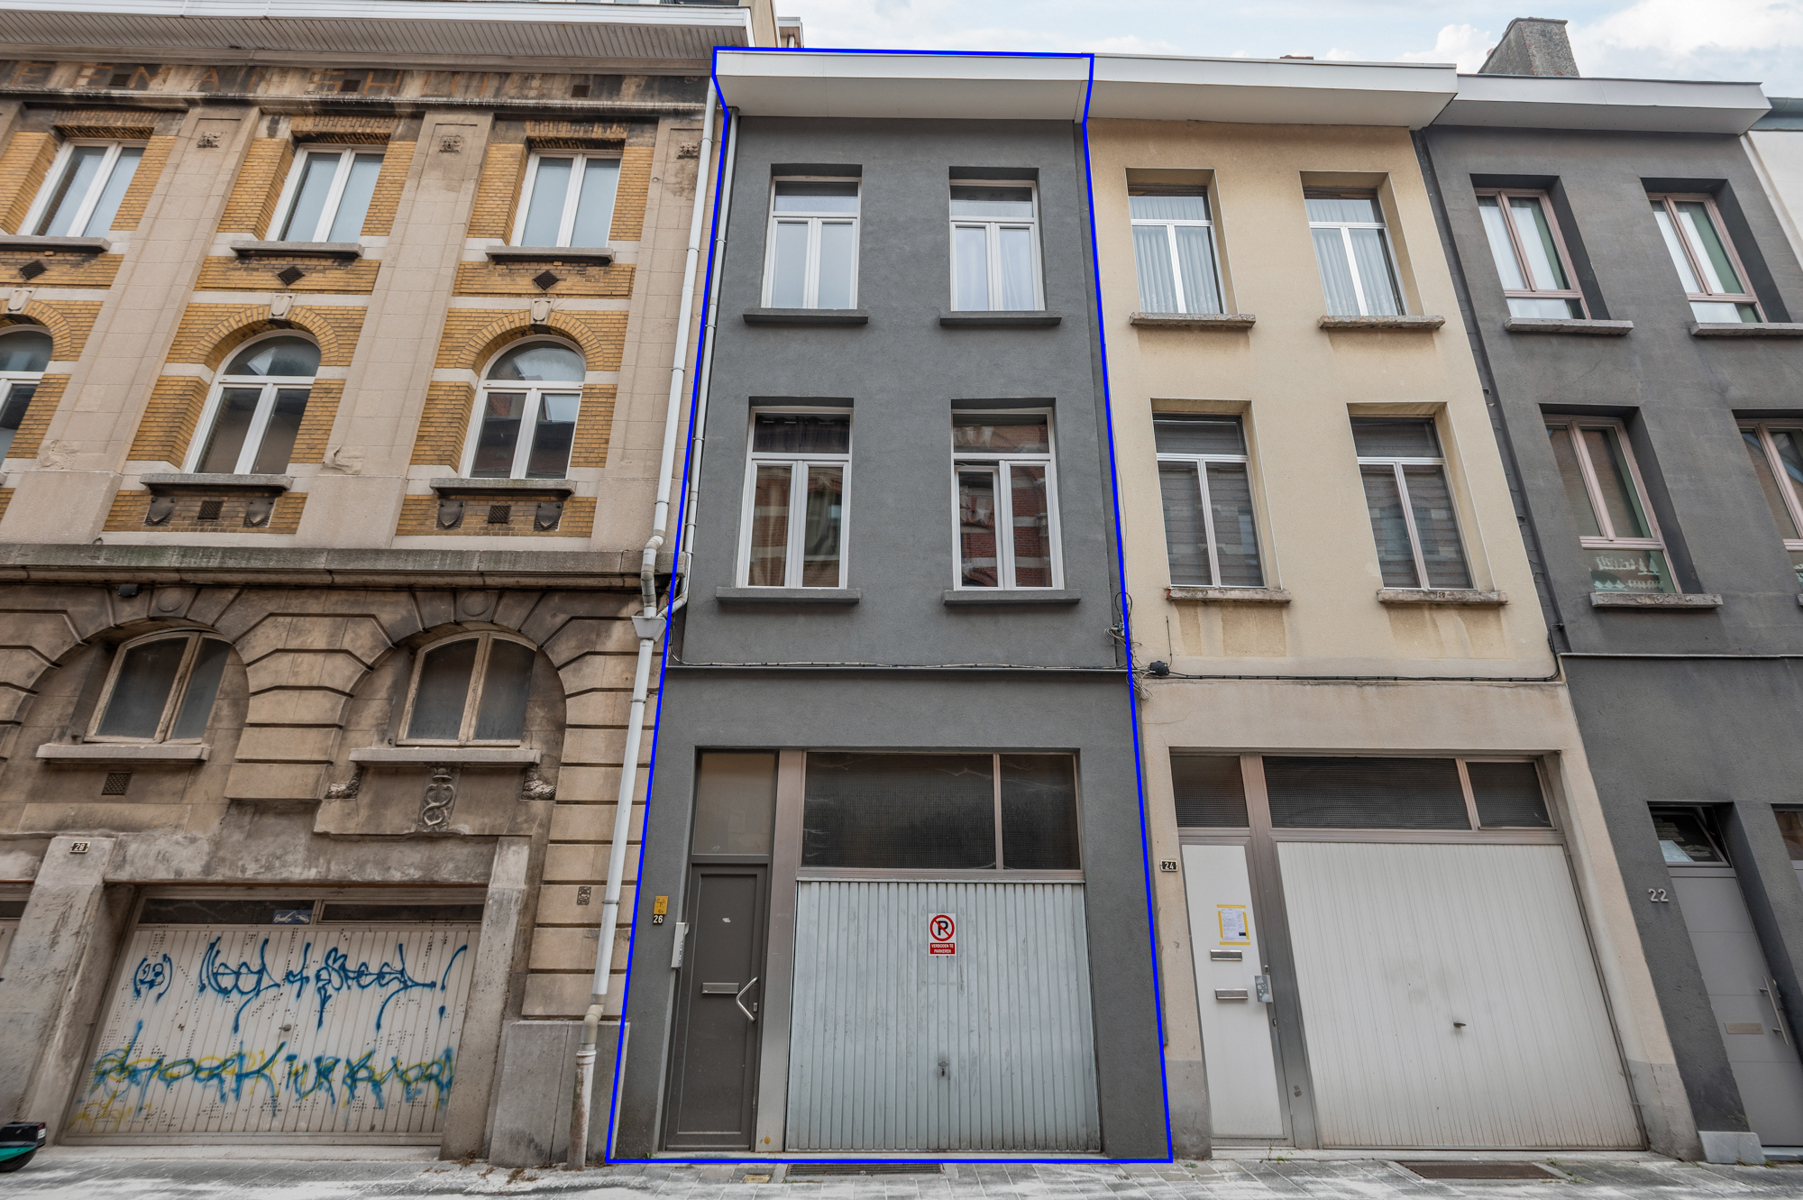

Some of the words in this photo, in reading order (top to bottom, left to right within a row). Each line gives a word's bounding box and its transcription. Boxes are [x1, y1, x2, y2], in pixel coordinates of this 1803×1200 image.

[74, 843, 85, 851] 28
[1165, 861, 1174, 870] 24
[1648, 888, 1669, 902] 22
[653, 915, 664, 923] 26
[938, 921, 948, 935] P
